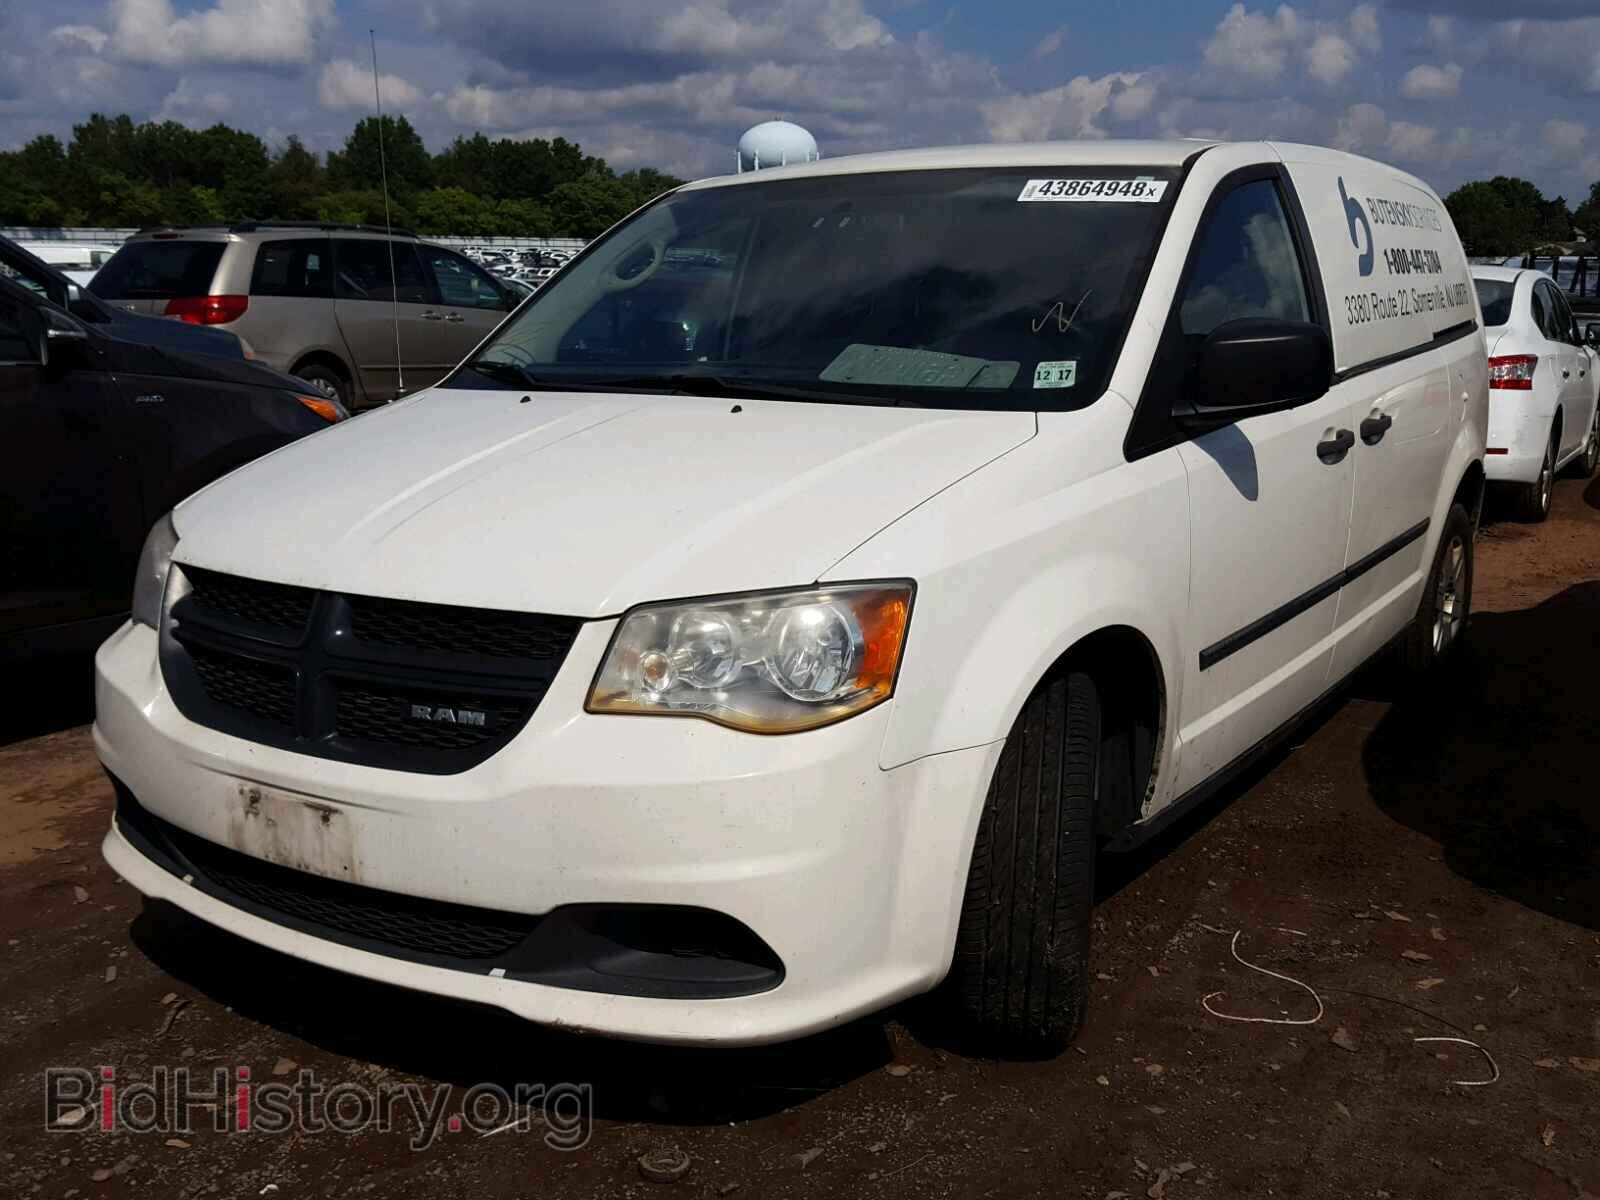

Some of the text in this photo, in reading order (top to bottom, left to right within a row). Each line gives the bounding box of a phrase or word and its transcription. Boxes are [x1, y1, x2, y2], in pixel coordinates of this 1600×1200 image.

[1345, 294, 1371, 325] 3380
[1371, 292, 1398, 320] Route
[1036, 369, 1072, 380] 12 17
[411, 704, 485, 726] RAM
